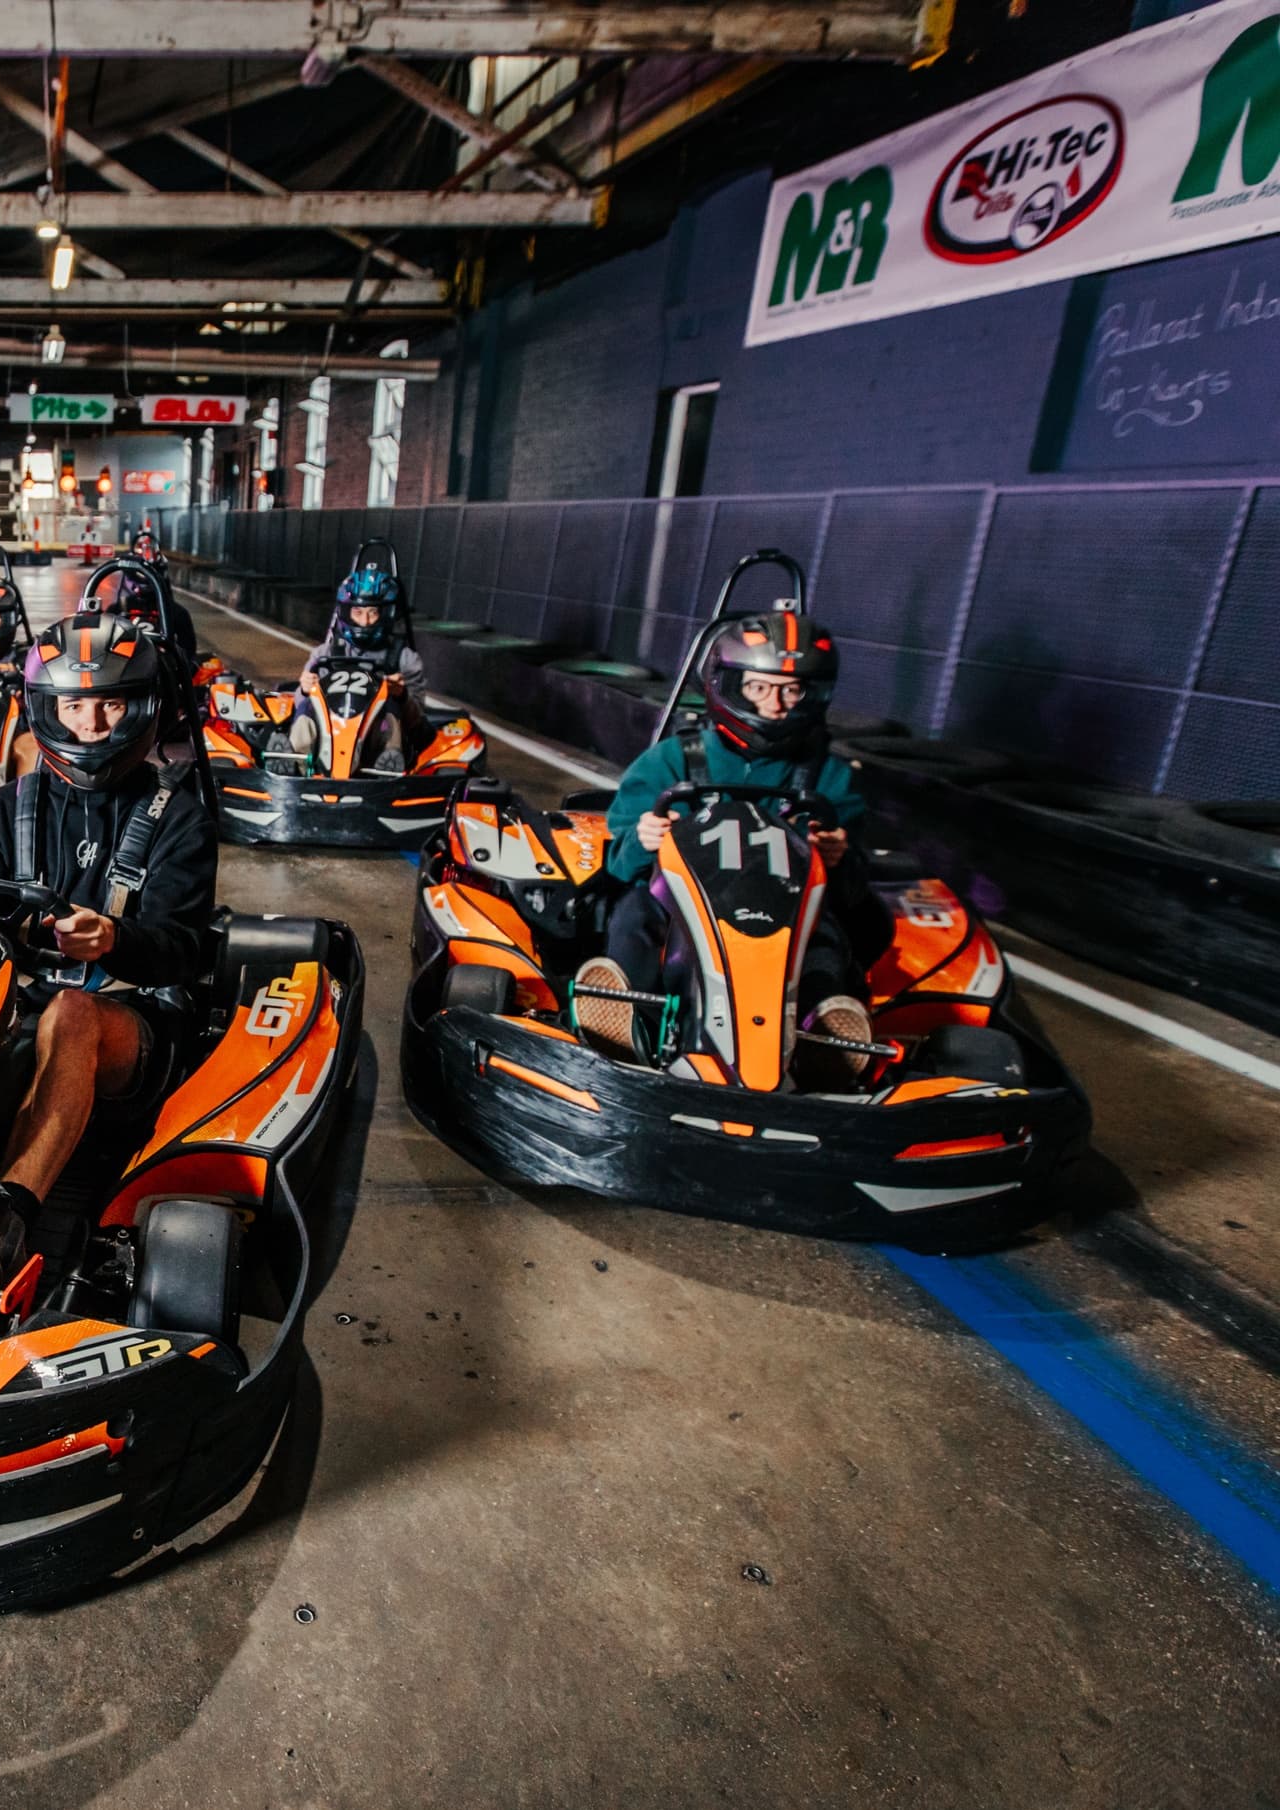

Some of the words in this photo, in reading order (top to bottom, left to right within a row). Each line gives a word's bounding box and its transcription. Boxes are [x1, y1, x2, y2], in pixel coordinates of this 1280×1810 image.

[987, 121, 1110, 190] Hi-Tec
[327, 671, 369, 695] 22
[700, 819, 790, 878] 11
[245, 976, 307, 1038] GTR
[39, 1338, 173, 1390] GTR
